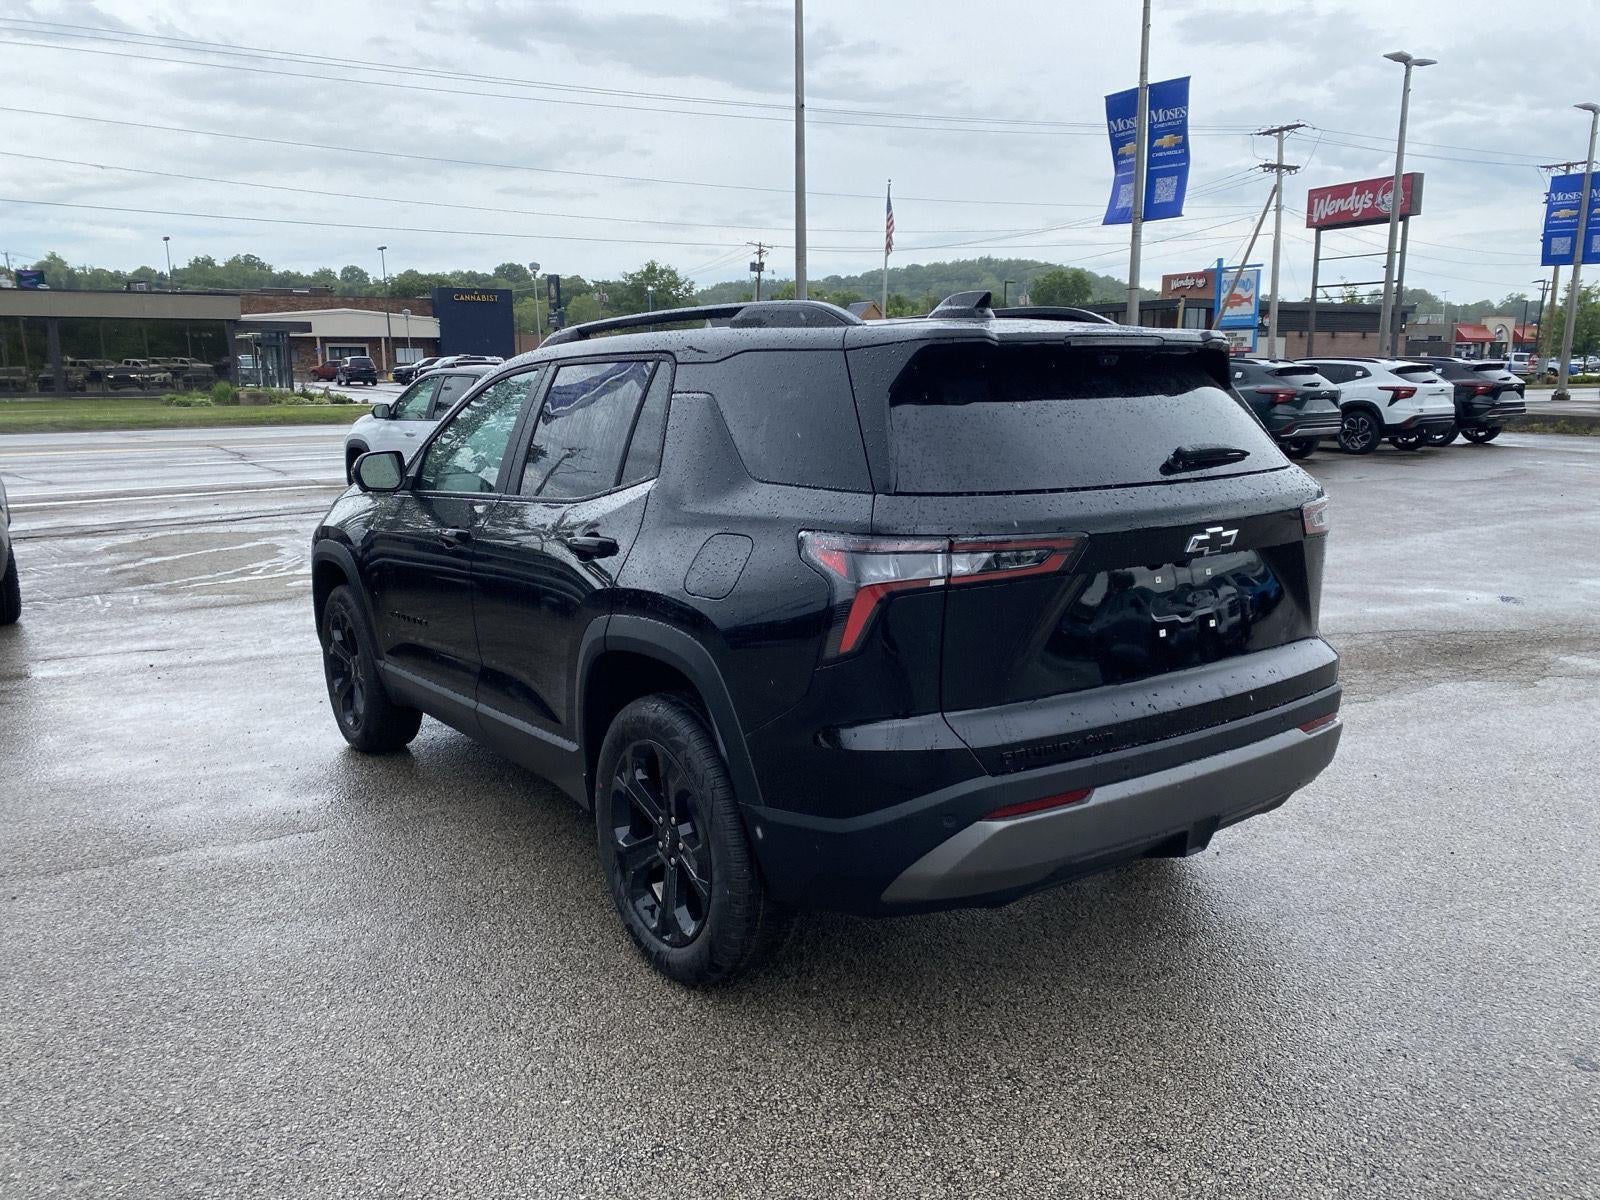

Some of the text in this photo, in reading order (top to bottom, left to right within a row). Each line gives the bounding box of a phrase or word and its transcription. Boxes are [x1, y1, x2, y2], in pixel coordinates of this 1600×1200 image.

[1149, 106, 1187, 123] MOSES
[1109, 116, 1138, 134] MOS
[1312, 186, 1374, 223] Wendy's
[1170, 275, 1196, 291] Wendy's
[453, 293, 499, 302] CANNABIST
